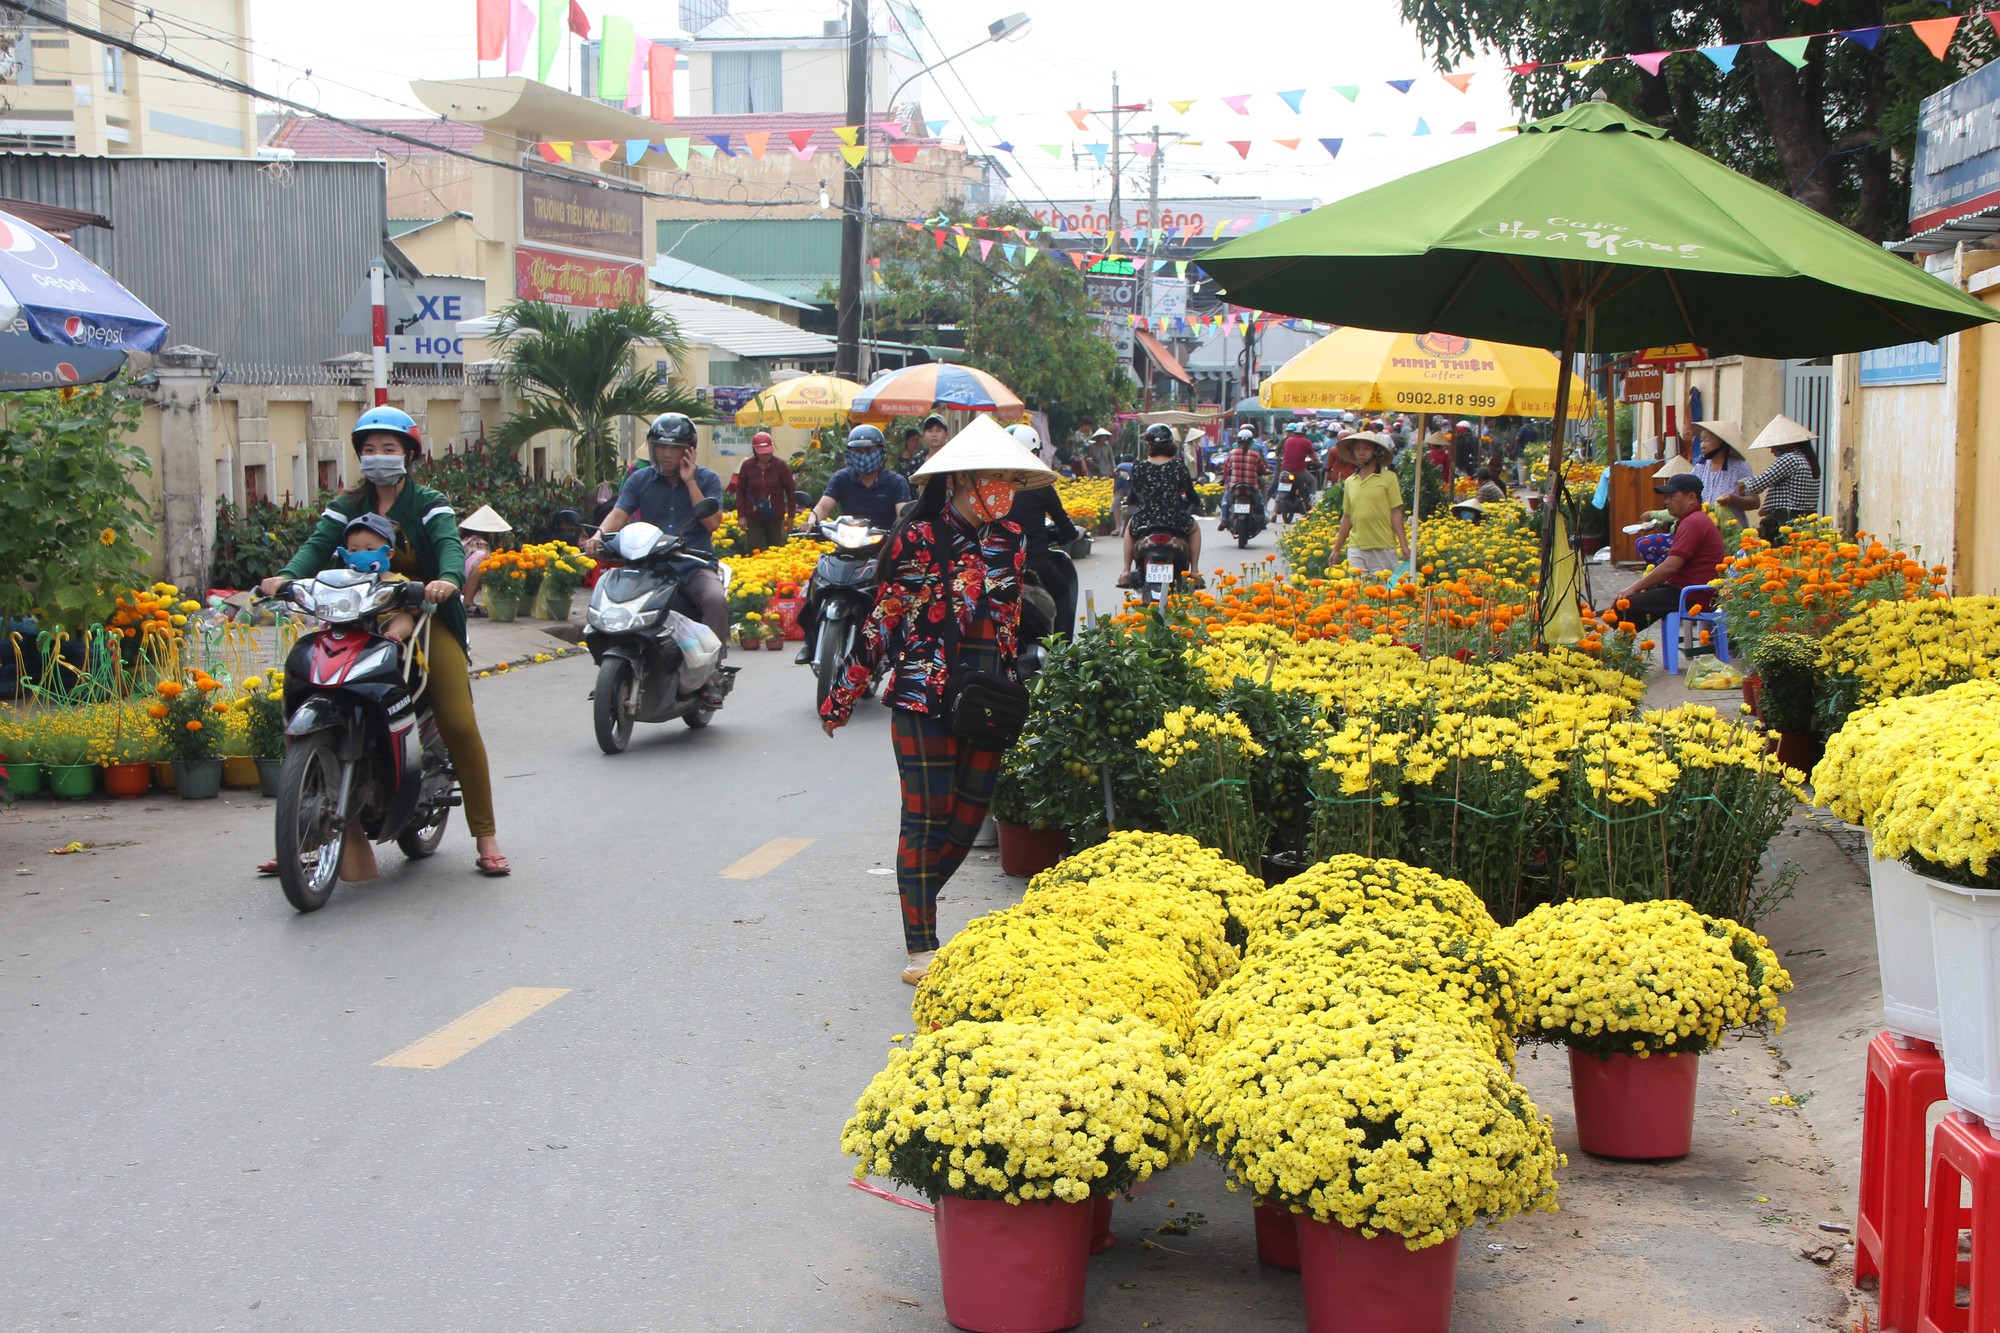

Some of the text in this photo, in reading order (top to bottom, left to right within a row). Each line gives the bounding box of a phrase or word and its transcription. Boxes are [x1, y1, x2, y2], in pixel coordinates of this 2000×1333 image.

[1034, 204, 1203, 236] Khoản Rêng
[31, 273, 93, 294] pepsi
[416, 295, 462, 321] XE
[87, 325, 124, 346] pepsi
[1392, 357, 1437, 370] MINH
[1627, 369, 1660, 378] MATCHA
[1424, 370, 1464, 381] Coffee
[1396, 391, 1464, 406] 0902.818
[1469, 394, 1496, 408] 999
[387, 695, 411, 716] YAMAHA
